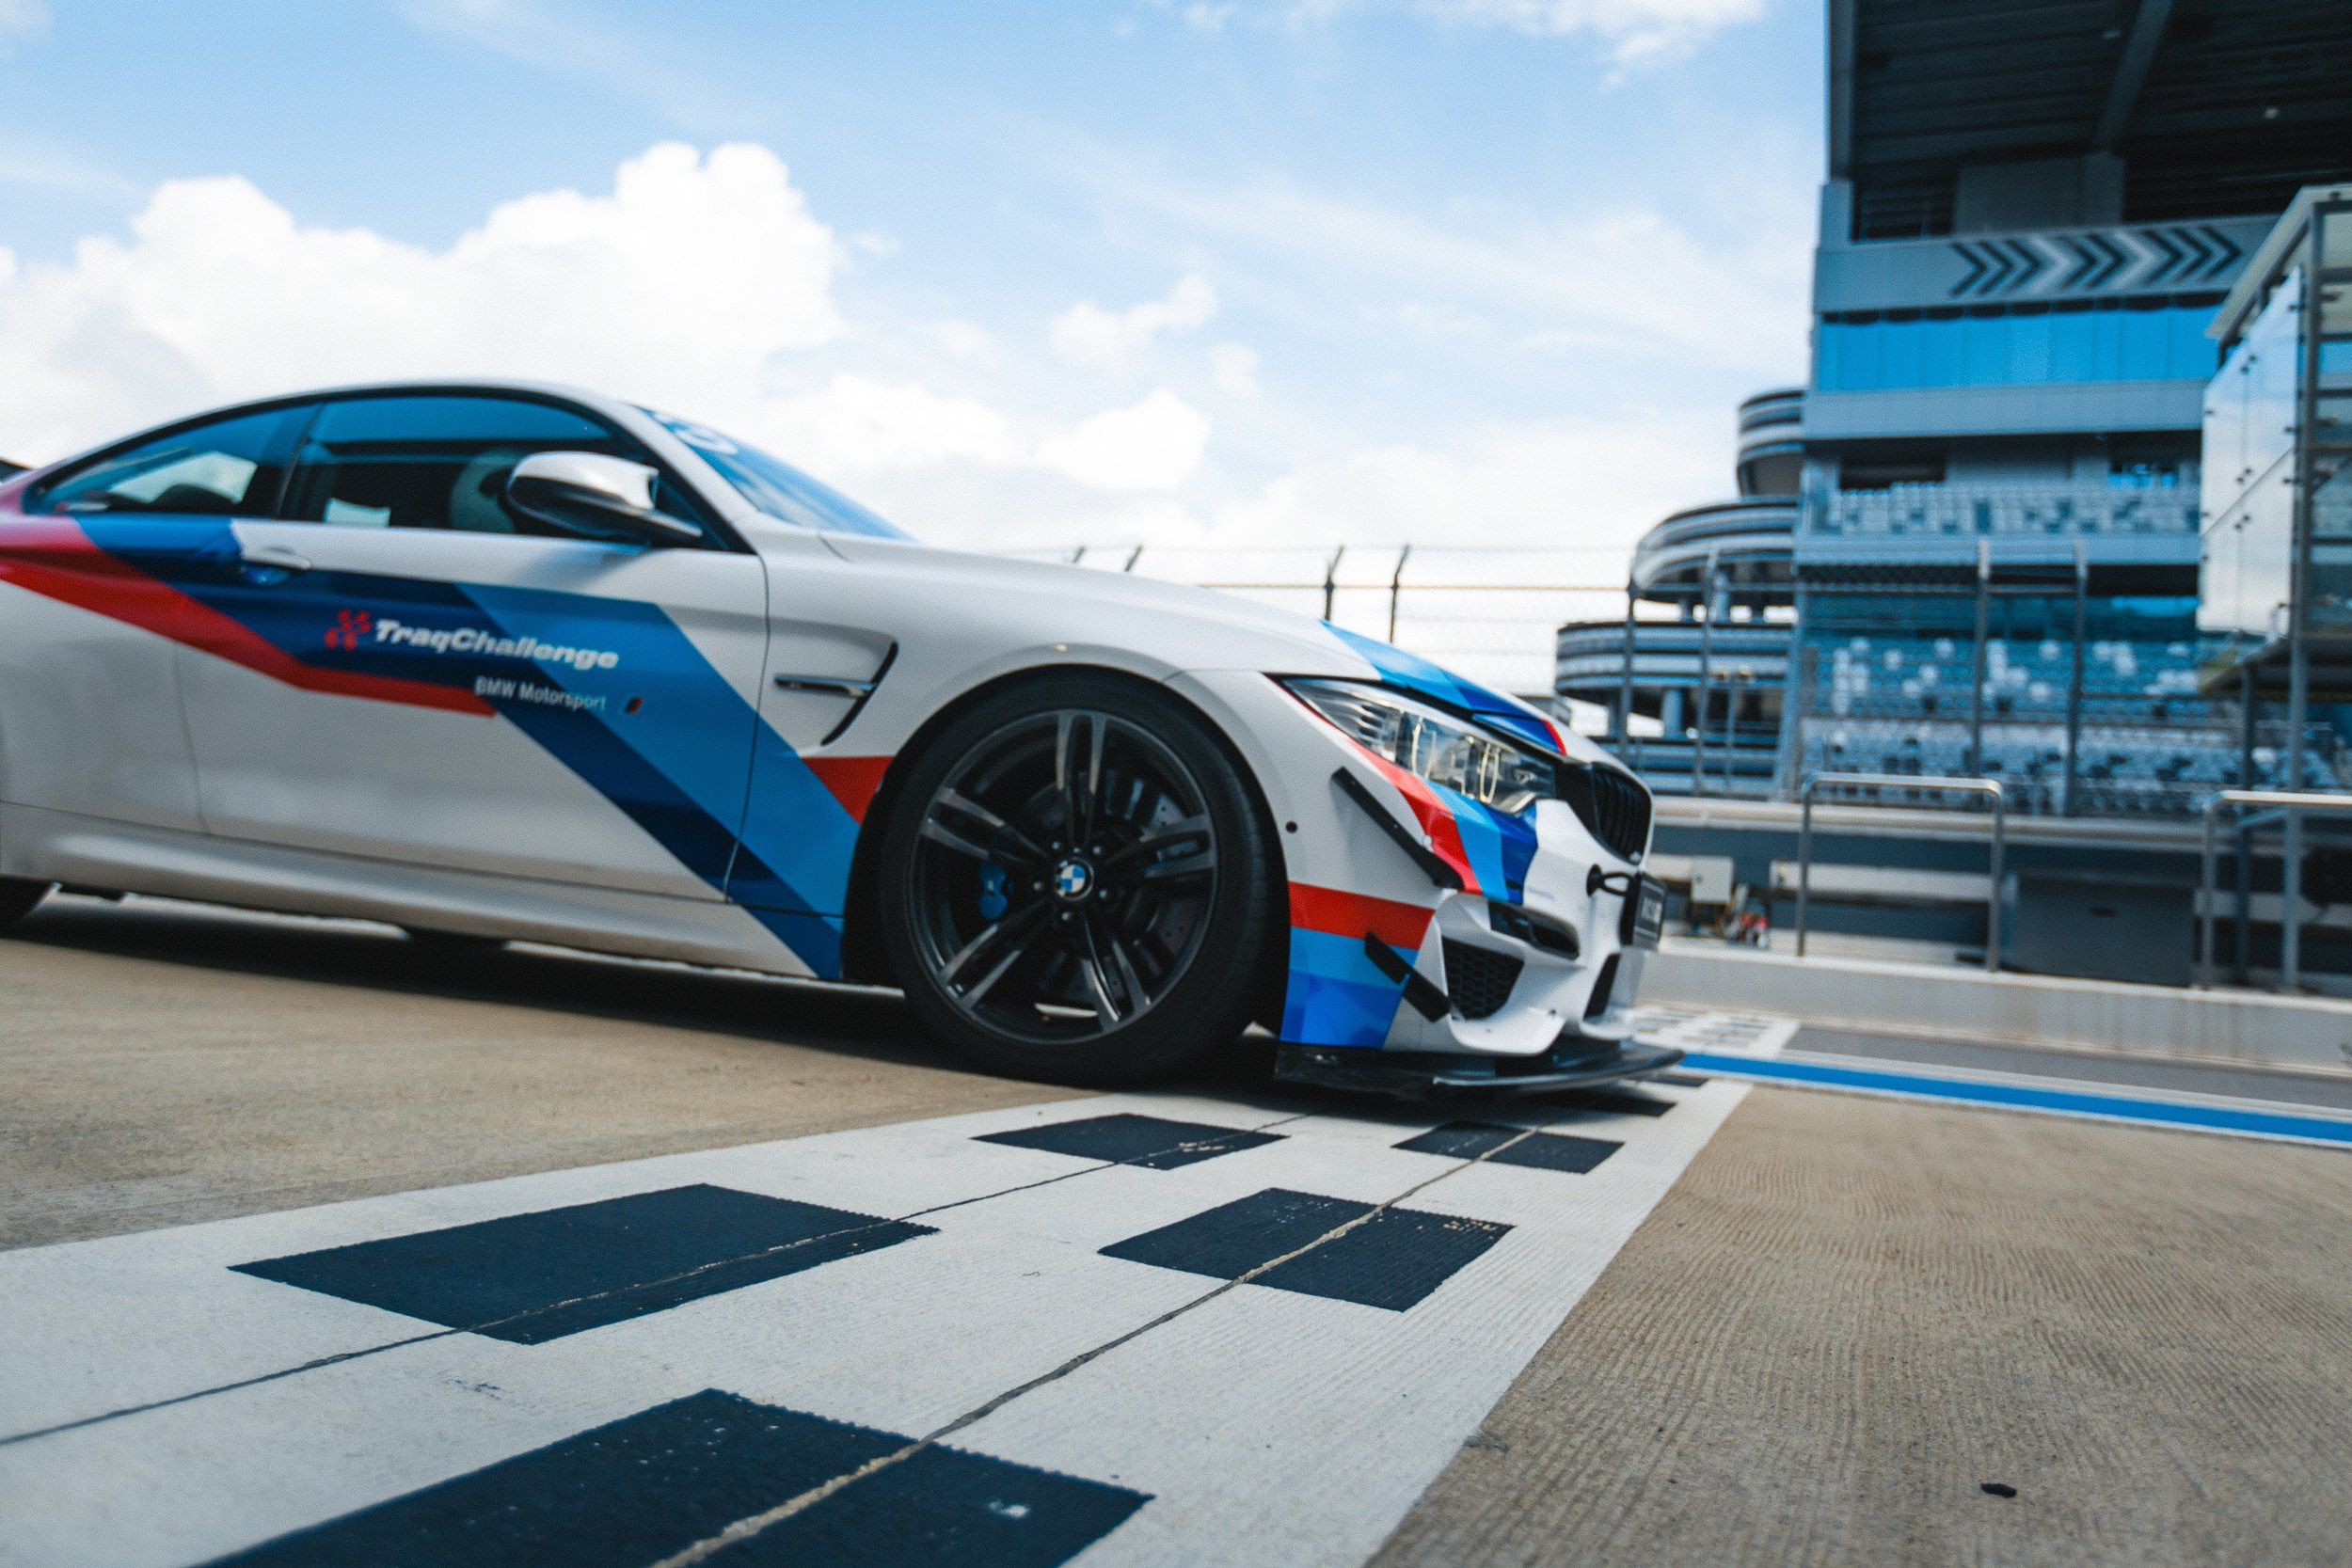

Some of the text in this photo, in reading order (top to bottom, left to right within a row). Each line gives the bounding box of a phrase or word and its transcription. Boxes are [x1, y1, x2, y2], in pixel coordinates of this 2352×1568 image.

[375, 619, 619, 670] TraqChallenge
[475, 676, 605, 712] BMW Motorsport
